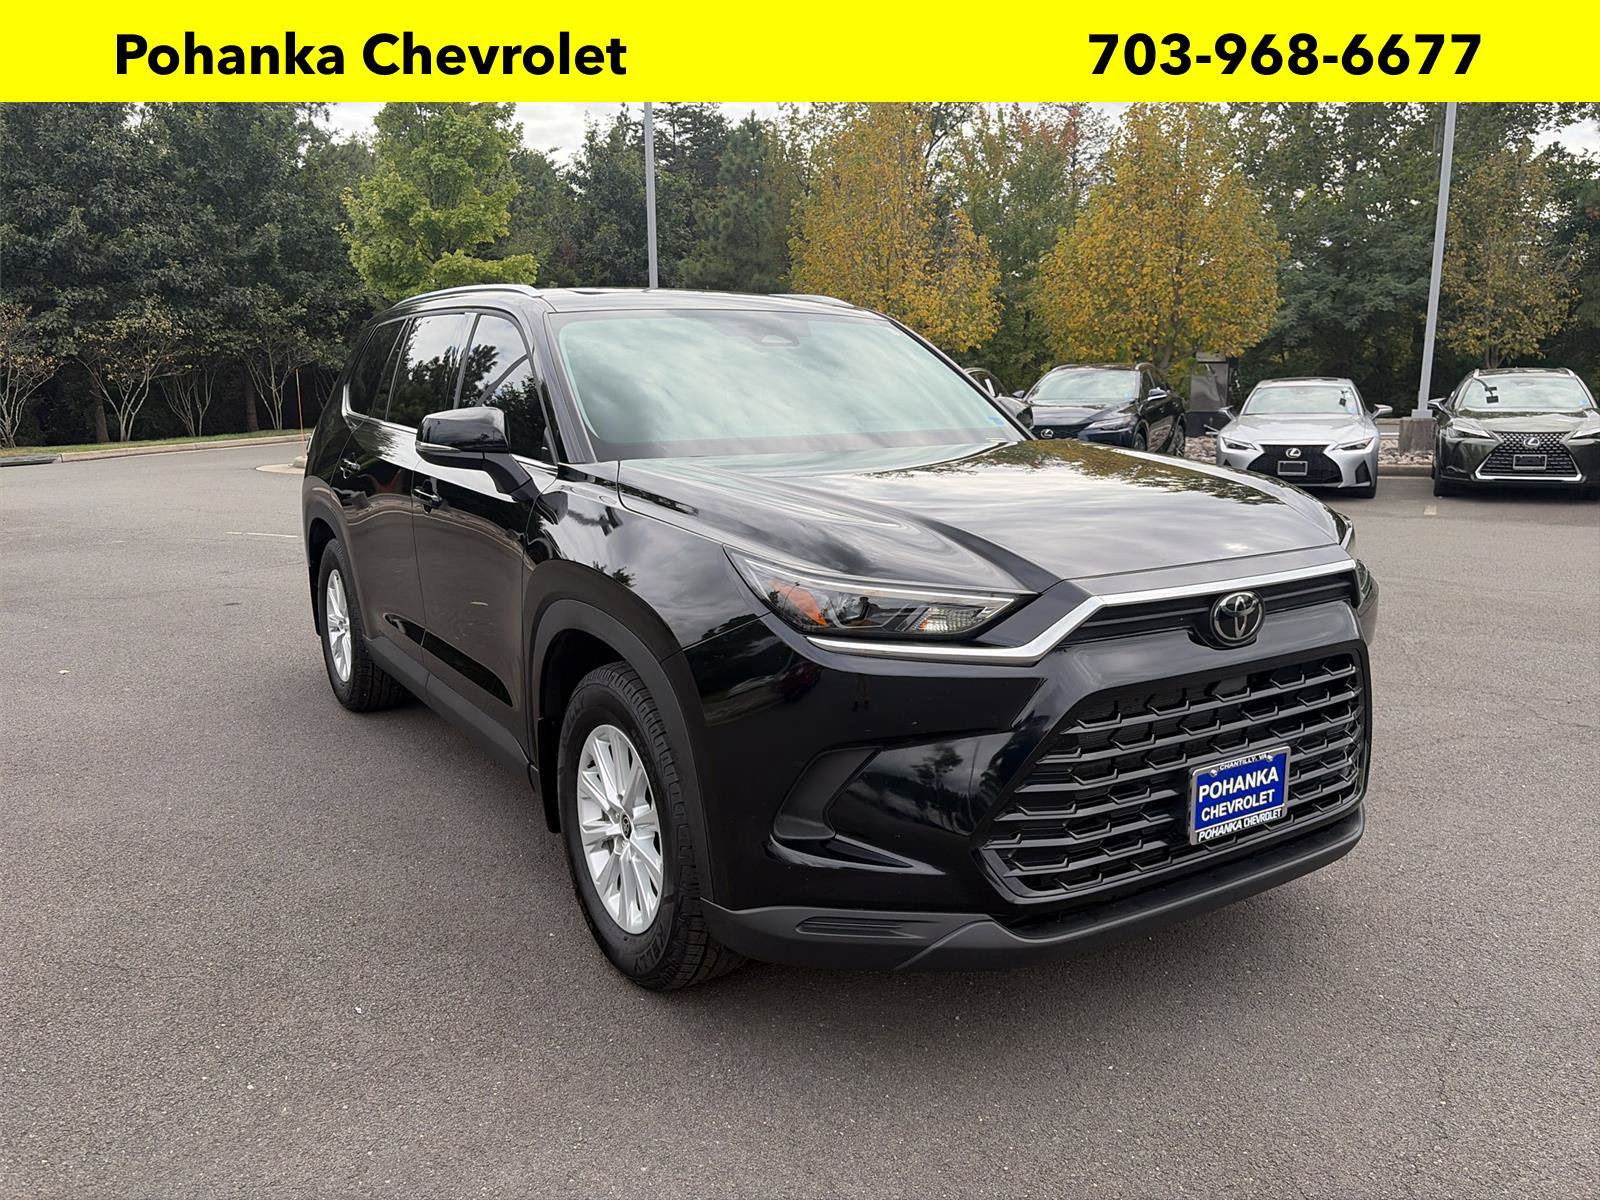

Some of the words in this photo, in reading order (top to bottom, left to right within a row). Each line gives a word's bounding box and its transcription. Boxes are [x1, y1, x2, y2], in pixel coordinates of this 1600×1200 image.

[1198, 766, 1279, 803] POHANKA
[1201, 789, 1275, 821] CHEVROLET
[1198, 822, 1242, 842] POHANKA
[1243, 808, 1282, 828] CHEVROLET
